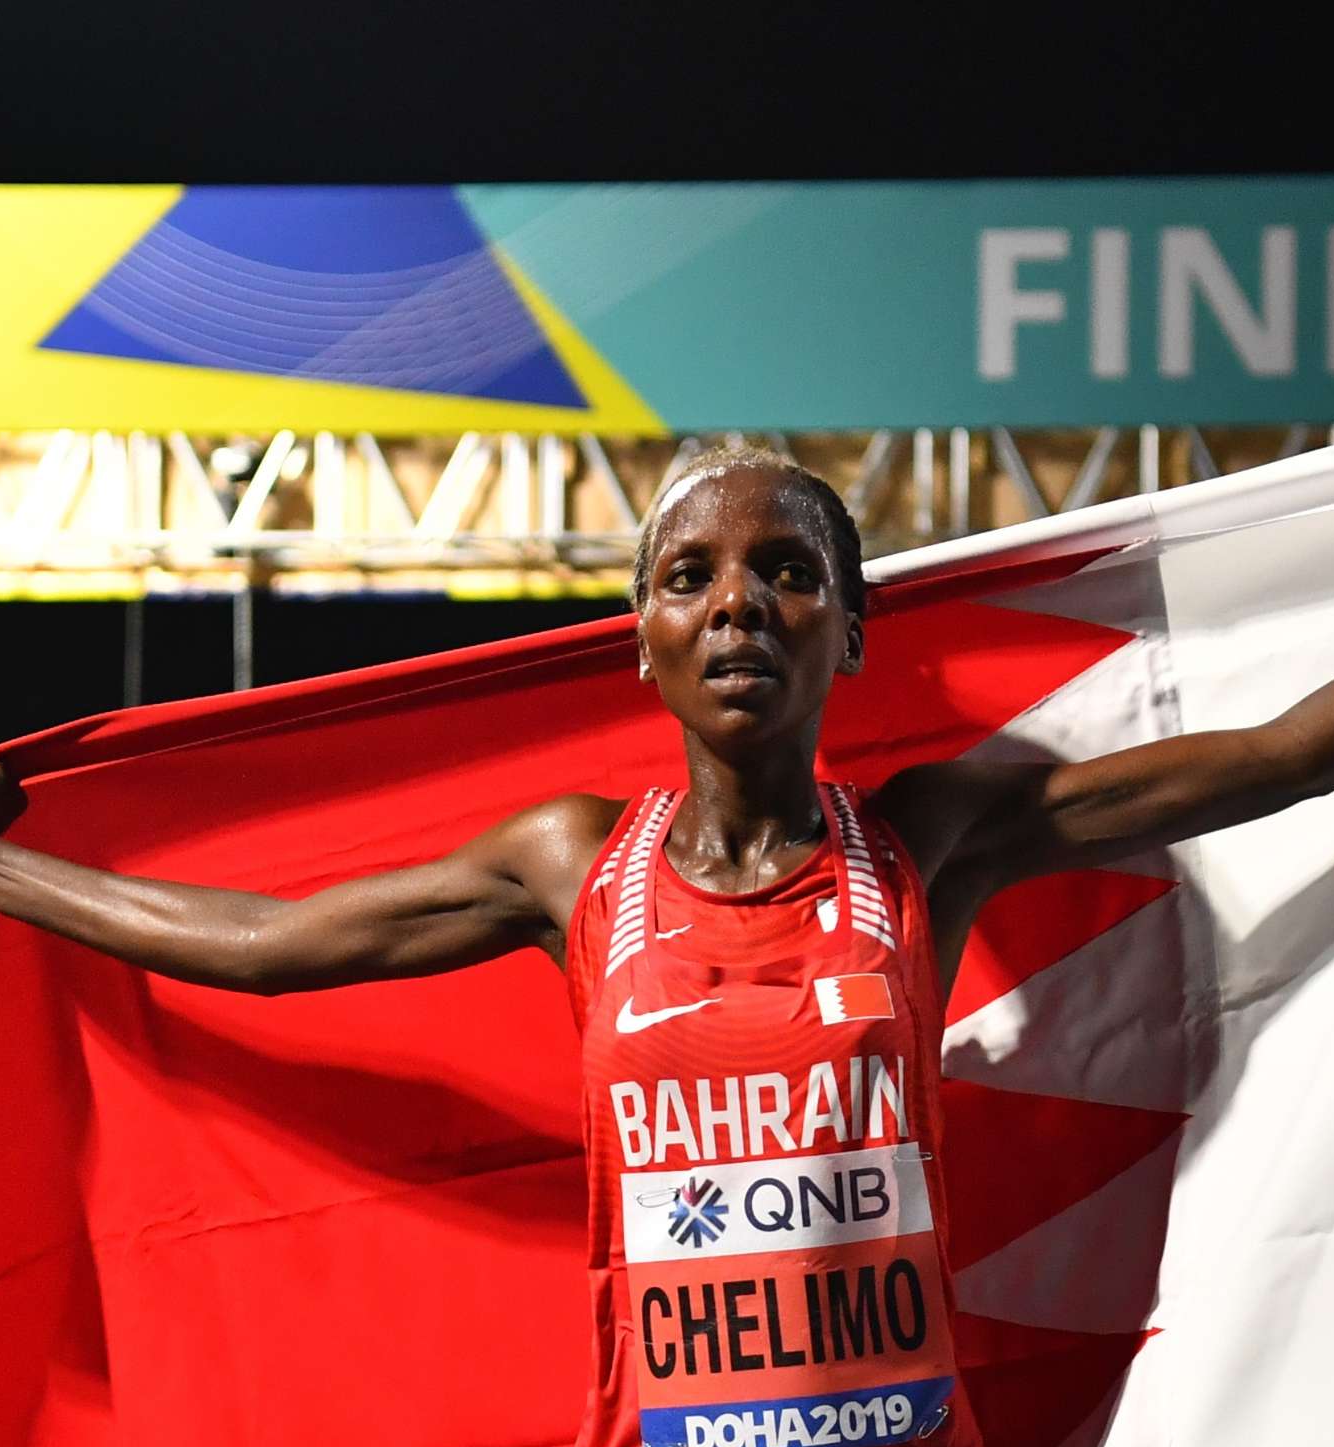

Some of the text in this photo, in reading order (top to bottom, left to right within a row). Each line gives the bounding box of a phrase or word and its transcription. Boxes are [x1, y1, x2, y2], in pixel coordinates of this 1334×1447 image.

[609, 1055, 908, 1168] BAHRAIN
[744, 1166, 891, 1233] QNB
[640, 1258, 927, 1380] CHELIMO
